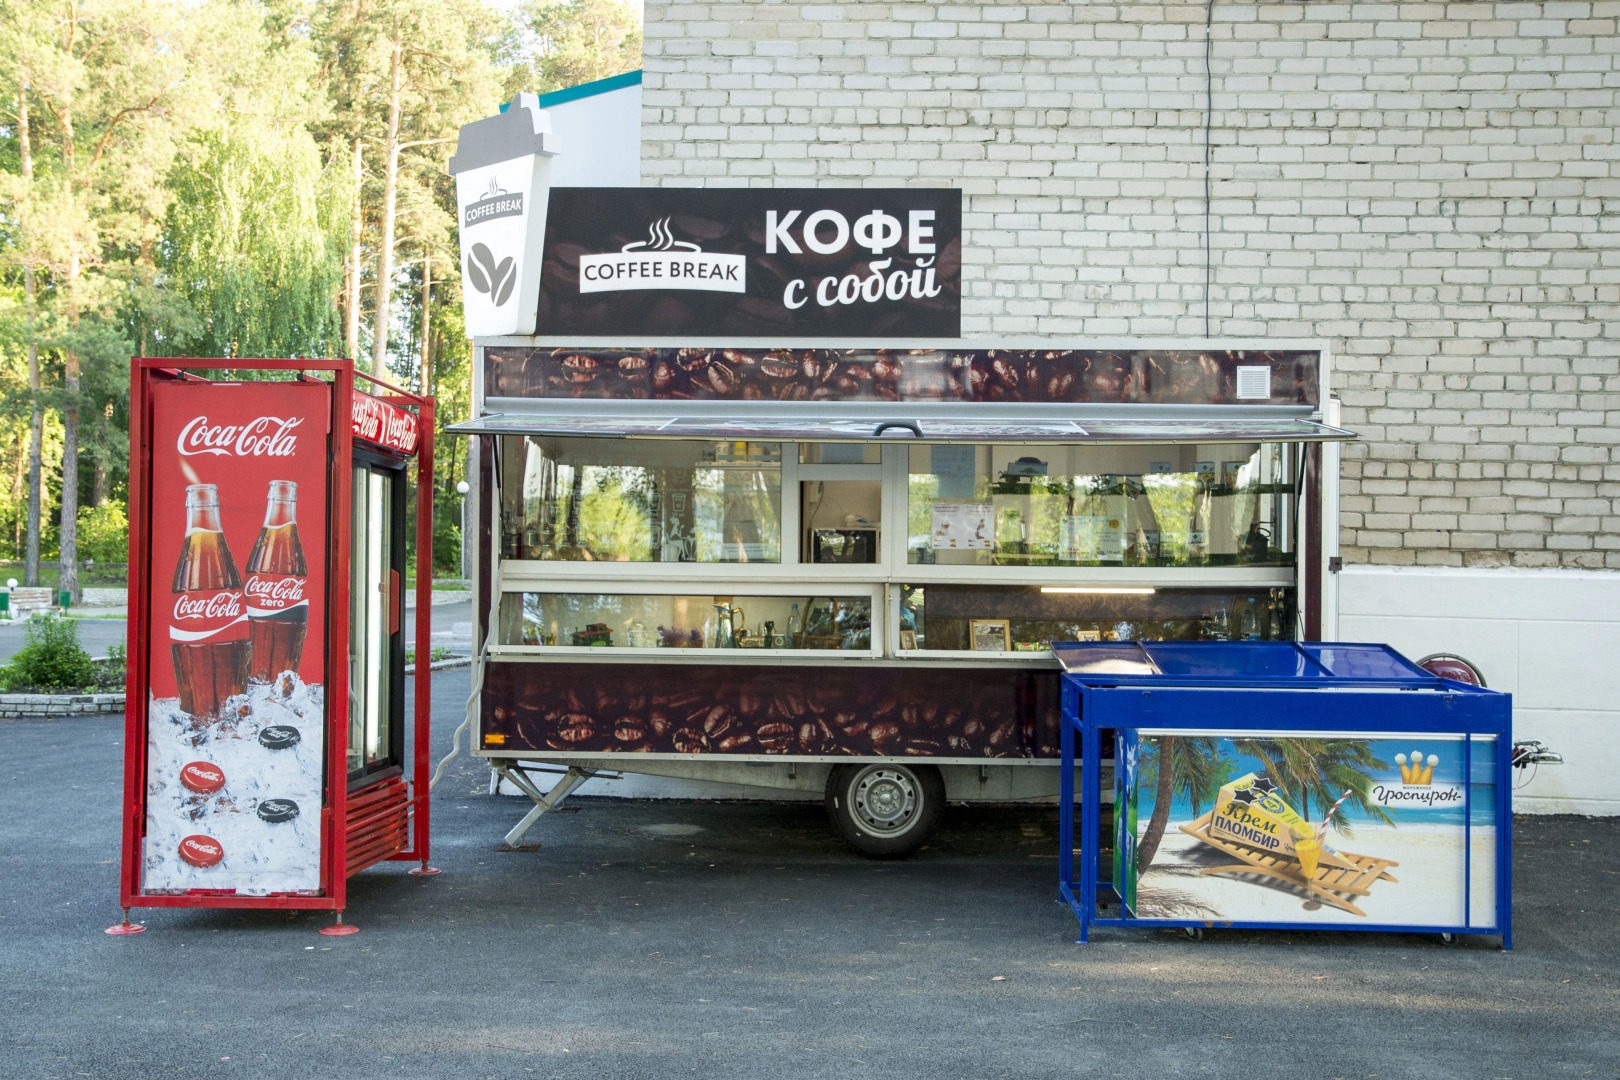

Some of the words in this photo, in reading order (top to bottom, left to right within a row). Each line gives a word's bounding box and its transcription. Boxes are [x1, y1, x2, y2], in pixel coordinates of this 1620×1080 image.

[466, 202, 495, 222] COFFEE
[496, 198, 522, 213] BREAK
[765, 209, 936, 255] КОФЕ
[584, 261, 663, 281] COFFEE
[670, 261, 739, 281] BREAK
[783, 278, 809, 310] с
[816, 256, 942, 307] собой
[176, 415, 305, 457] Coca-Cola
[243, 575, 307, 600] Coca-Cola
[173, 591, 243, 620] Coca-Cola
[260, 598, 285, 608] zero
[1214, 815, 1280, 850] ПЛОМБИР
[1222, 802, 1277, 834] Крем
